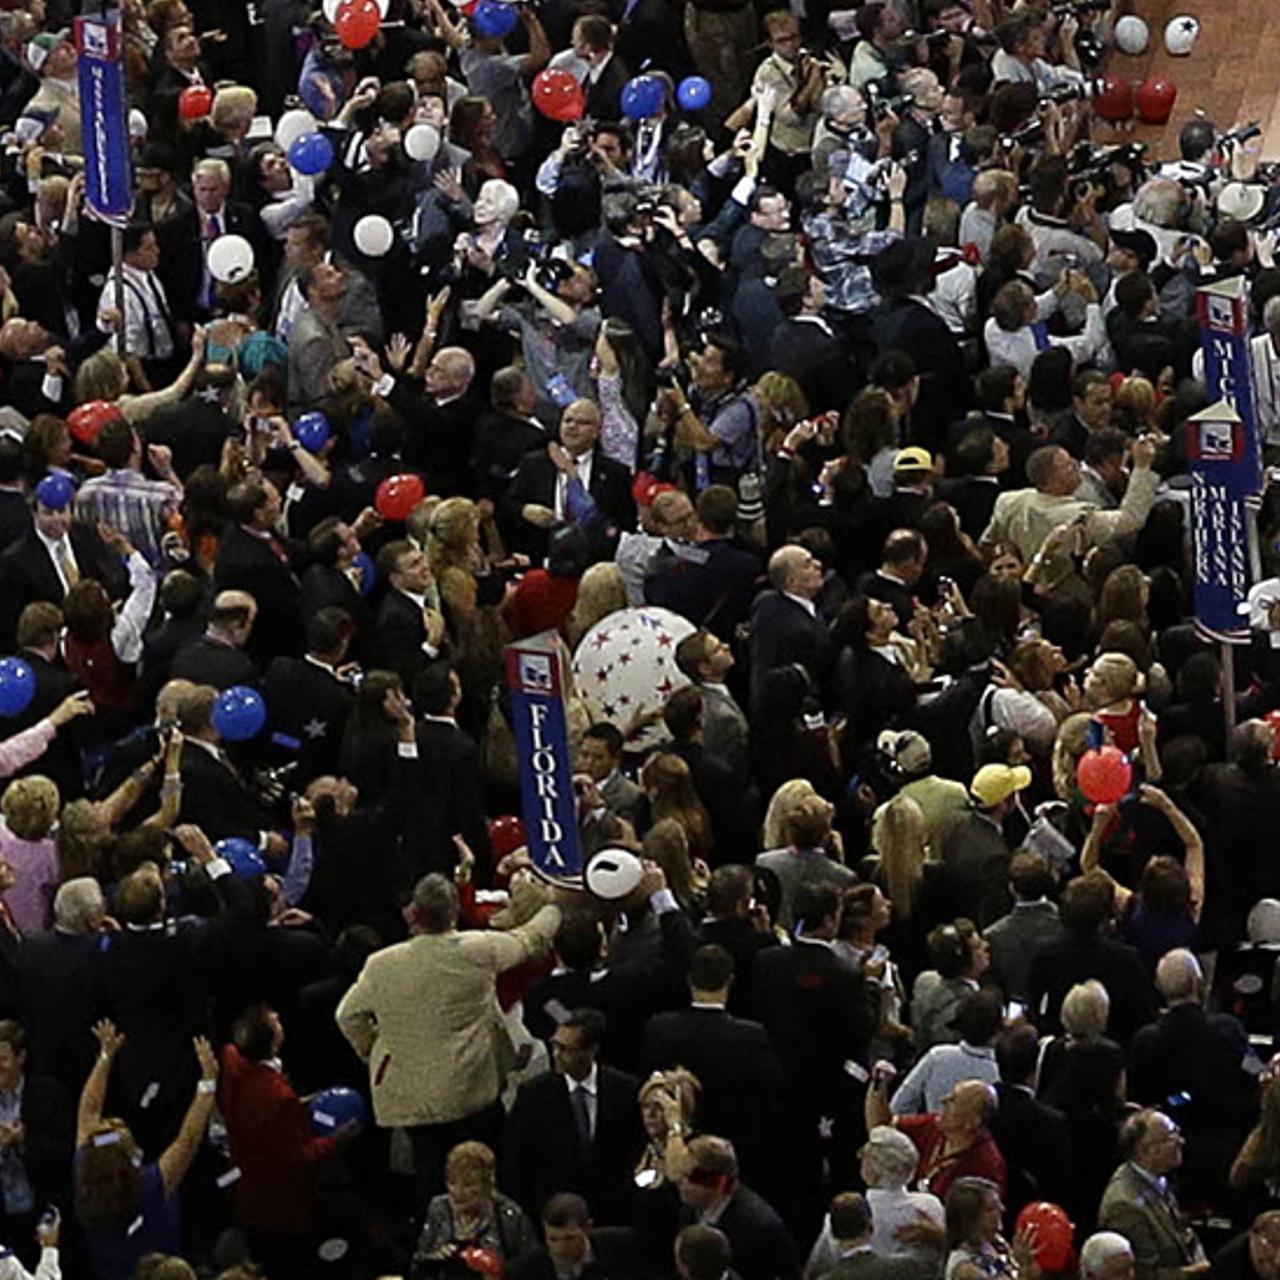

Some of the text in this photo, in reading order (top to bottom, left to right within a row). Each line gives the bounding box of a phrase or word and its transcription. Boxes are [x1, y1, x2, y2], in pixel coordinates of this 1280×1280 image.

[1191, 471, 1209, 584] NORTHERN
[1209, 486, 1228, 586] MARIANA
[1230, 501, 1246, 600] ISLANDS
[529, 704, 566, 867] FLORIDA
